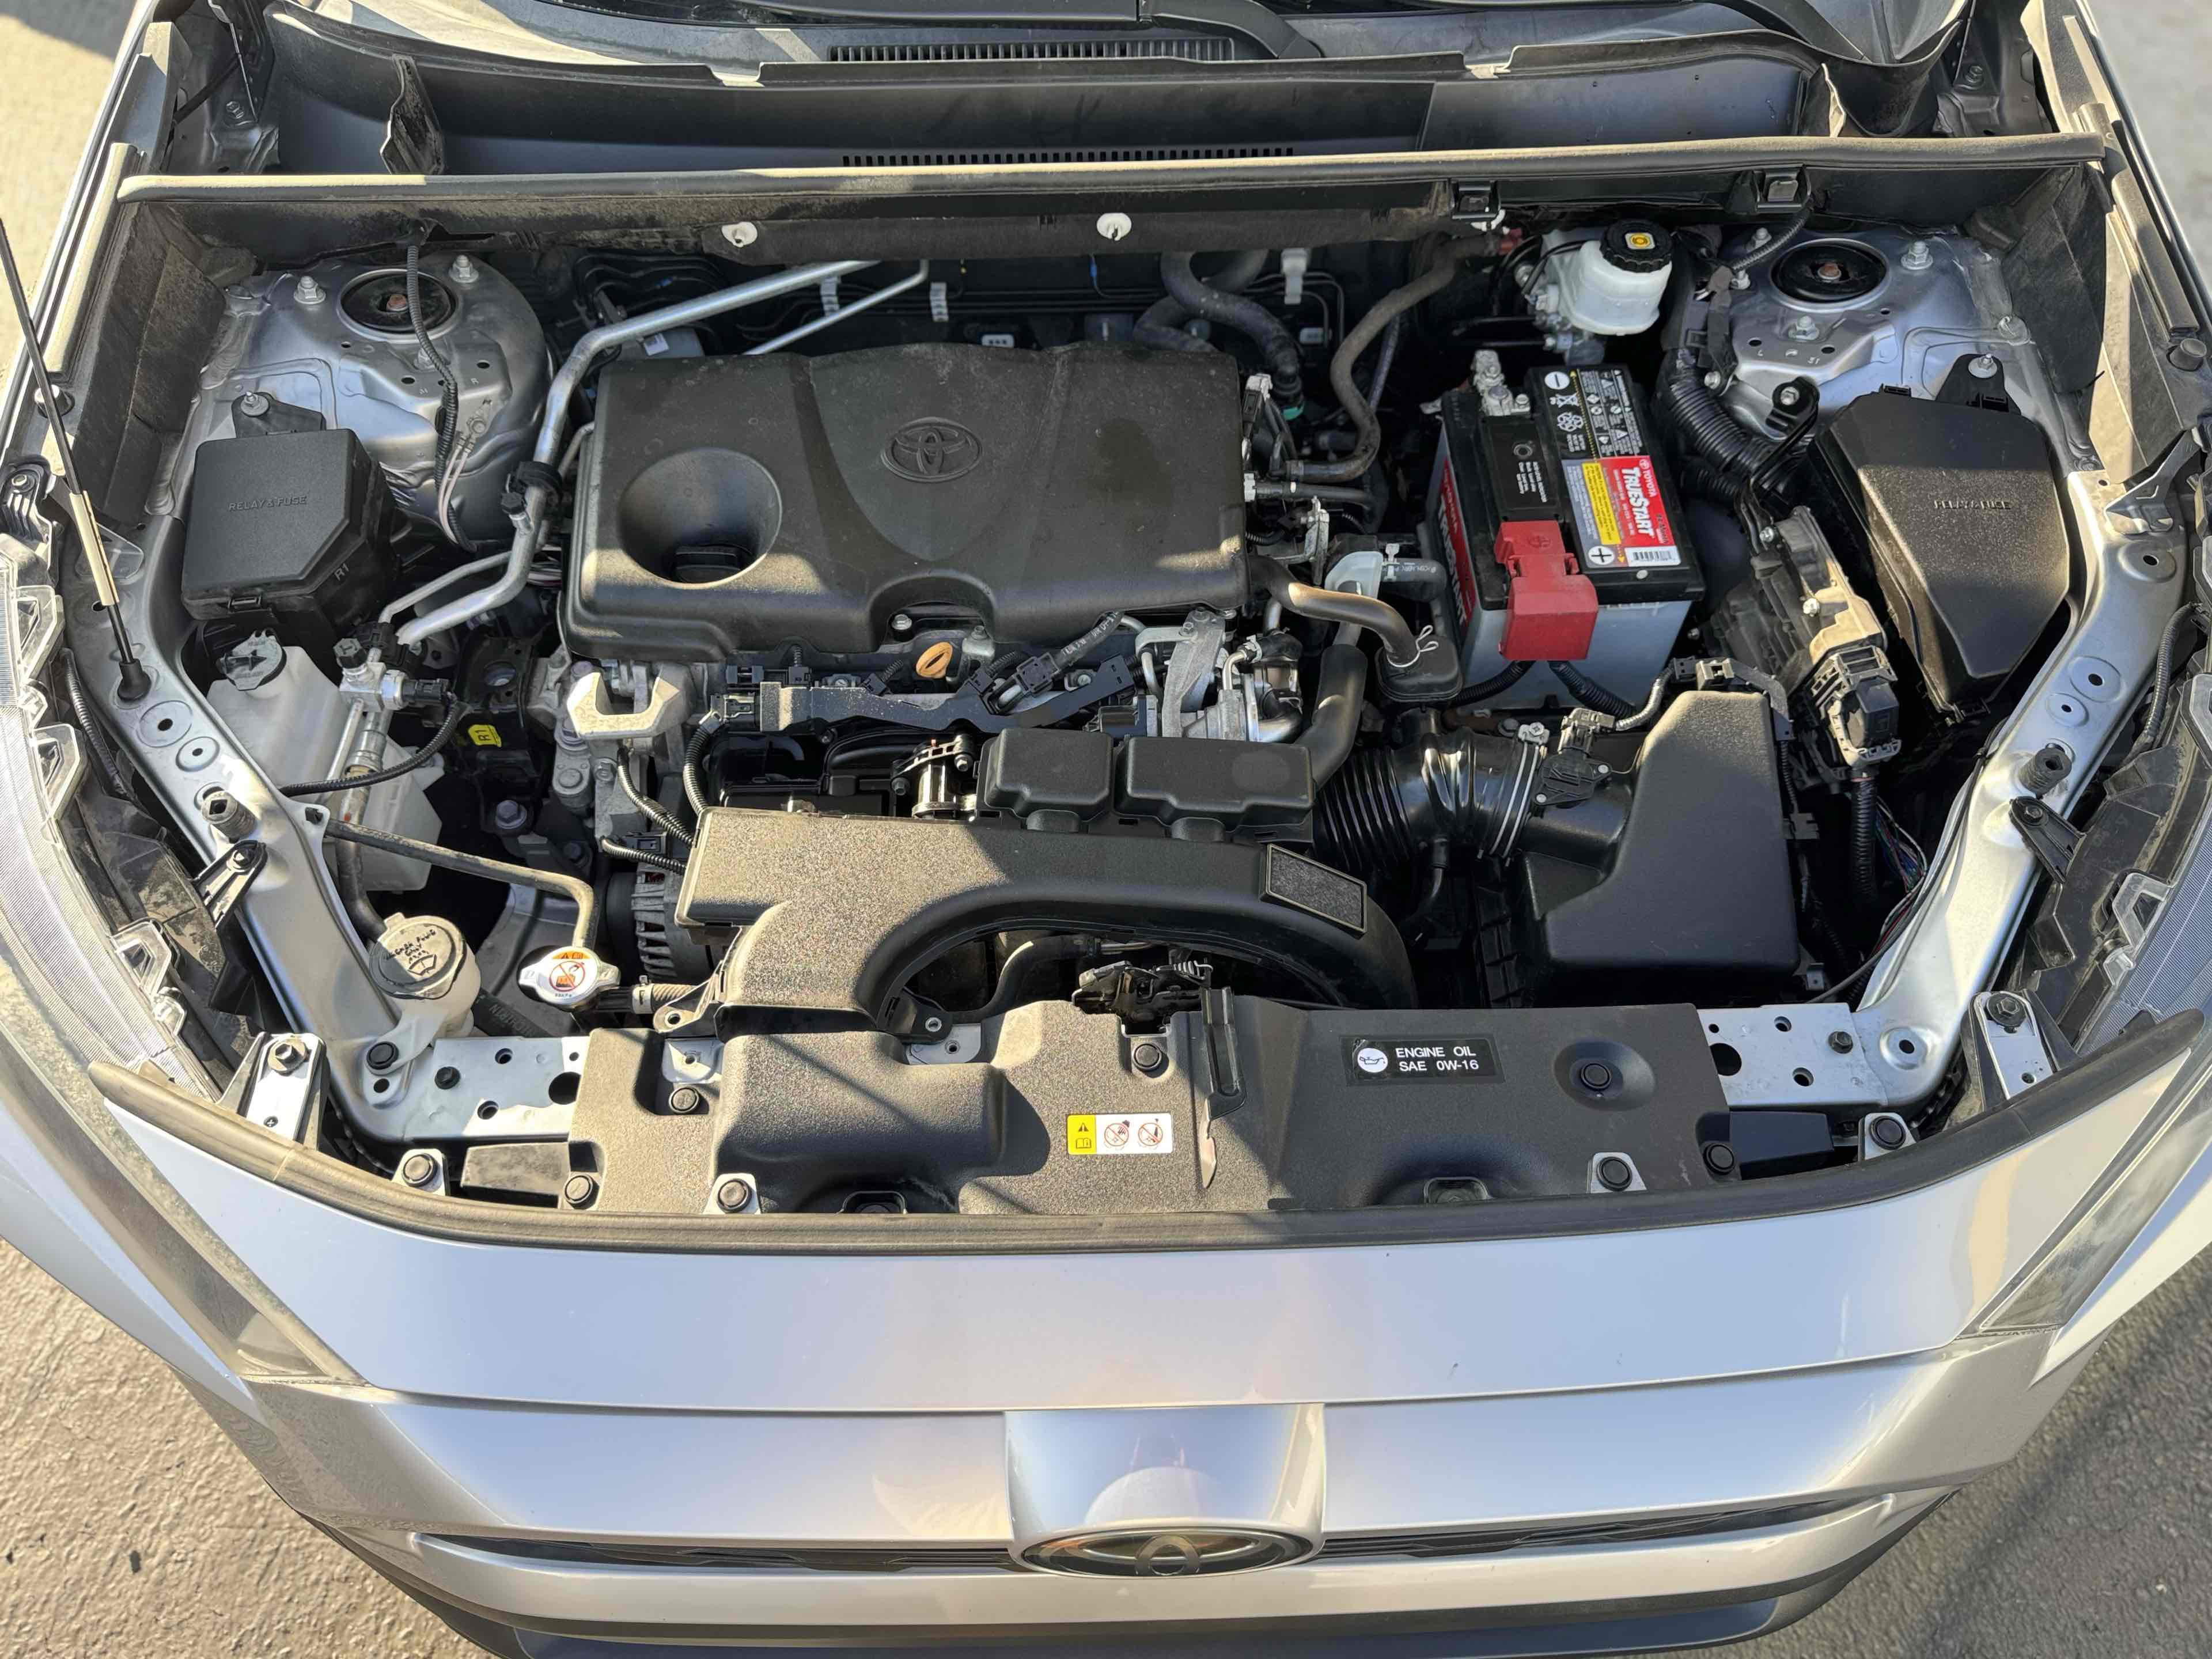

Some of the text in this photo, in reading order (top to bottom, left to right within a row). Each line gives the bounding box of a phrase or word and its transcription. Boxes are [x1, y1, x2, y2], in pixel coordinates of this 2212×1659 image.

[1642, 469, 1657, 498] TOYOTA
[229, 495, 308, 512] RELAY & FUSE
[334, 563, 350, 581] R1
[475, 729, 491, 741] R1
[1395, 1046, 1476, 1059] ENGINE OIL
[1399, 1059, 1479, 1072] SAE 0W-16
